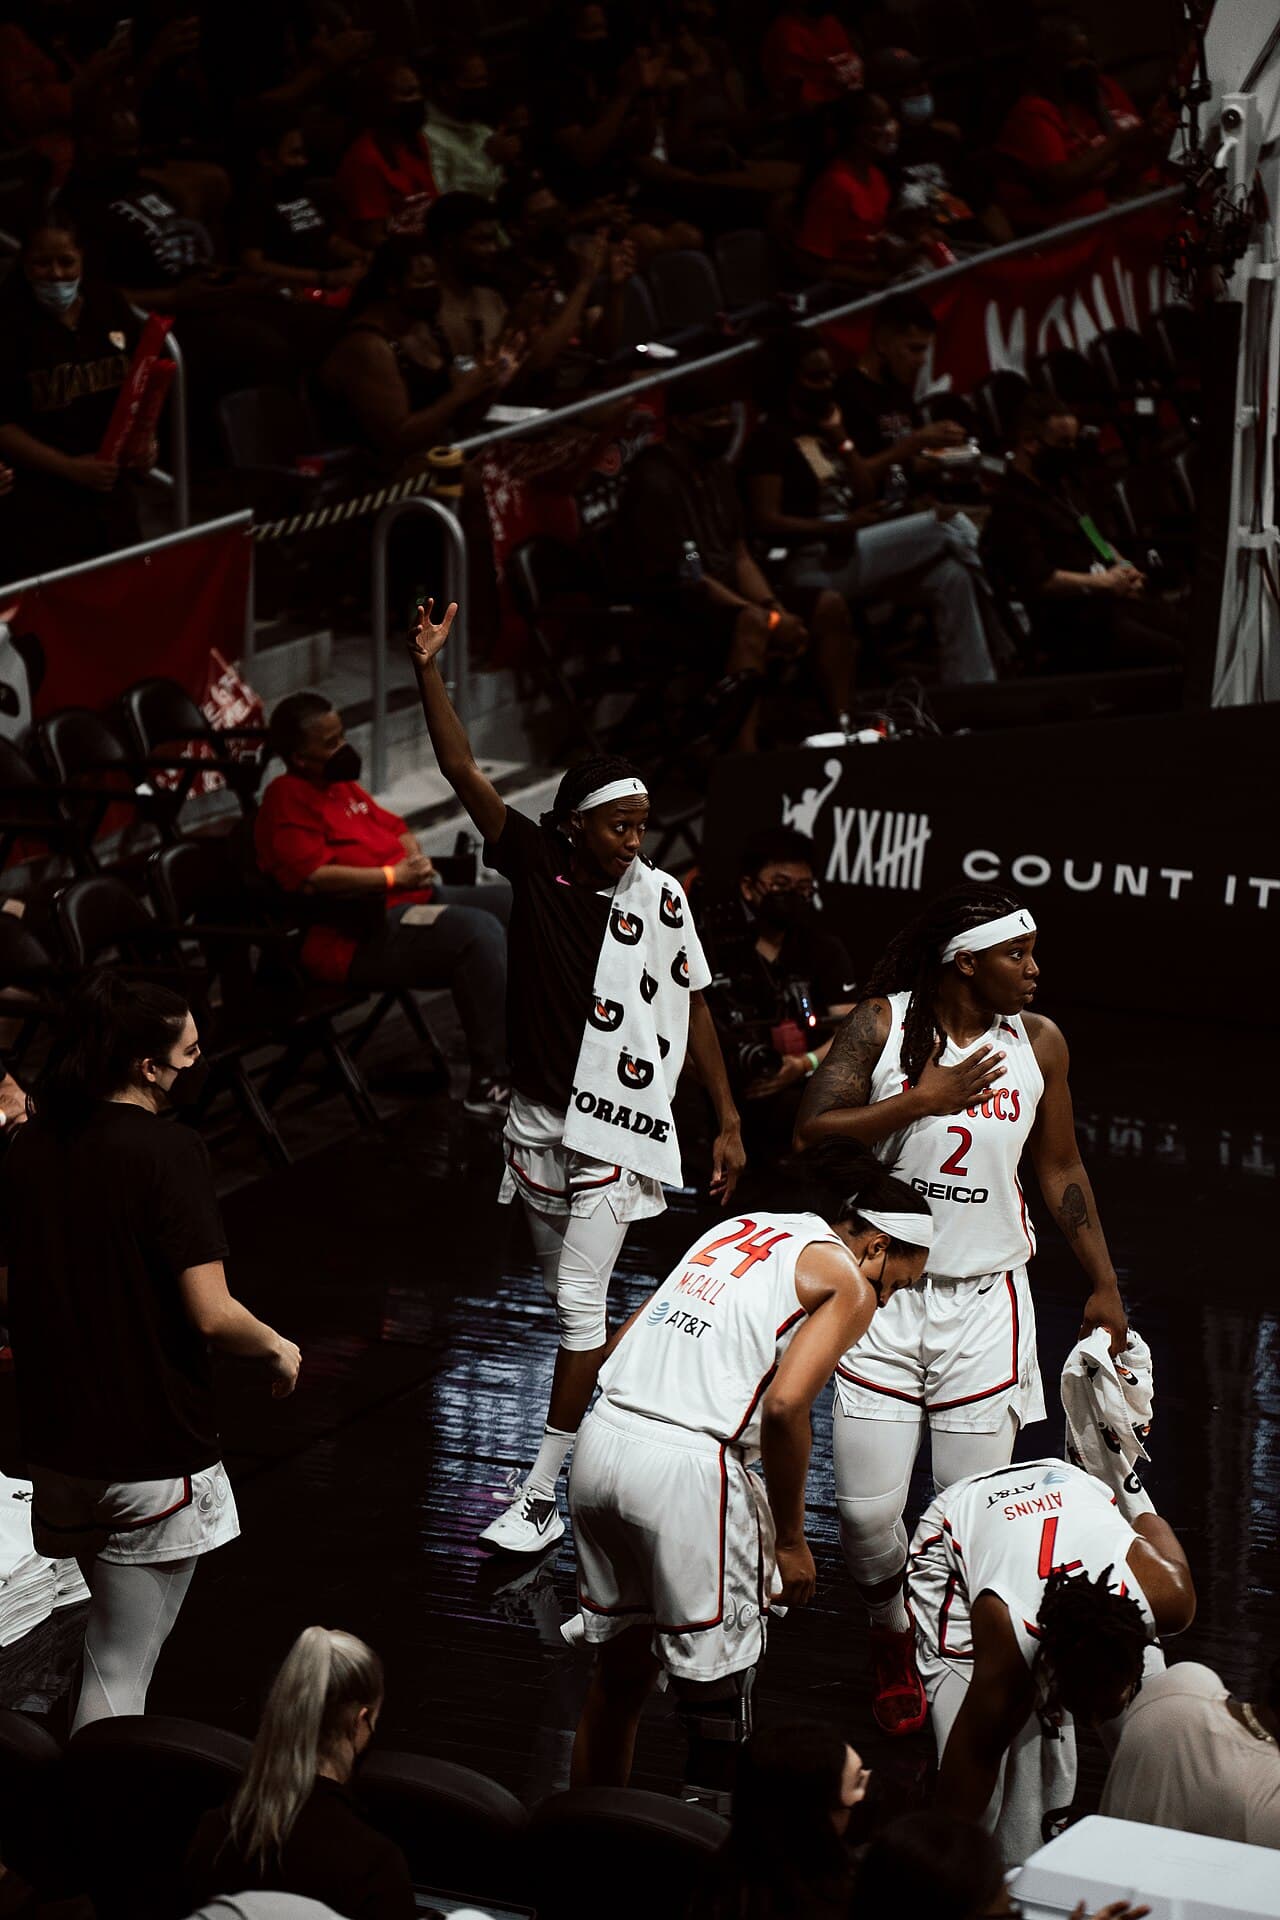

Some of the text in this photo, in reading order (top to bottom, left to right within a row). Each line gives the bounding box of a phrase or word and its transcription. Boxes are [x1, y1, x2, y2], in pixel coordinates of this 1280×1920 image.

[962, 849, 1280, 908] COUNT IT
[572, 1086, 670, 1143] ORADE
[939, 1125, 973, 1177] 2
[911, 1177, 989, 1204] GEICO
[687, 1218, 794, 1279] 24
[665, 1310, 712, 1338] AT&T
[986, 1482, 1036, 1509] AT&T
[1004, 1491, 1063, 1521] ATKINS
